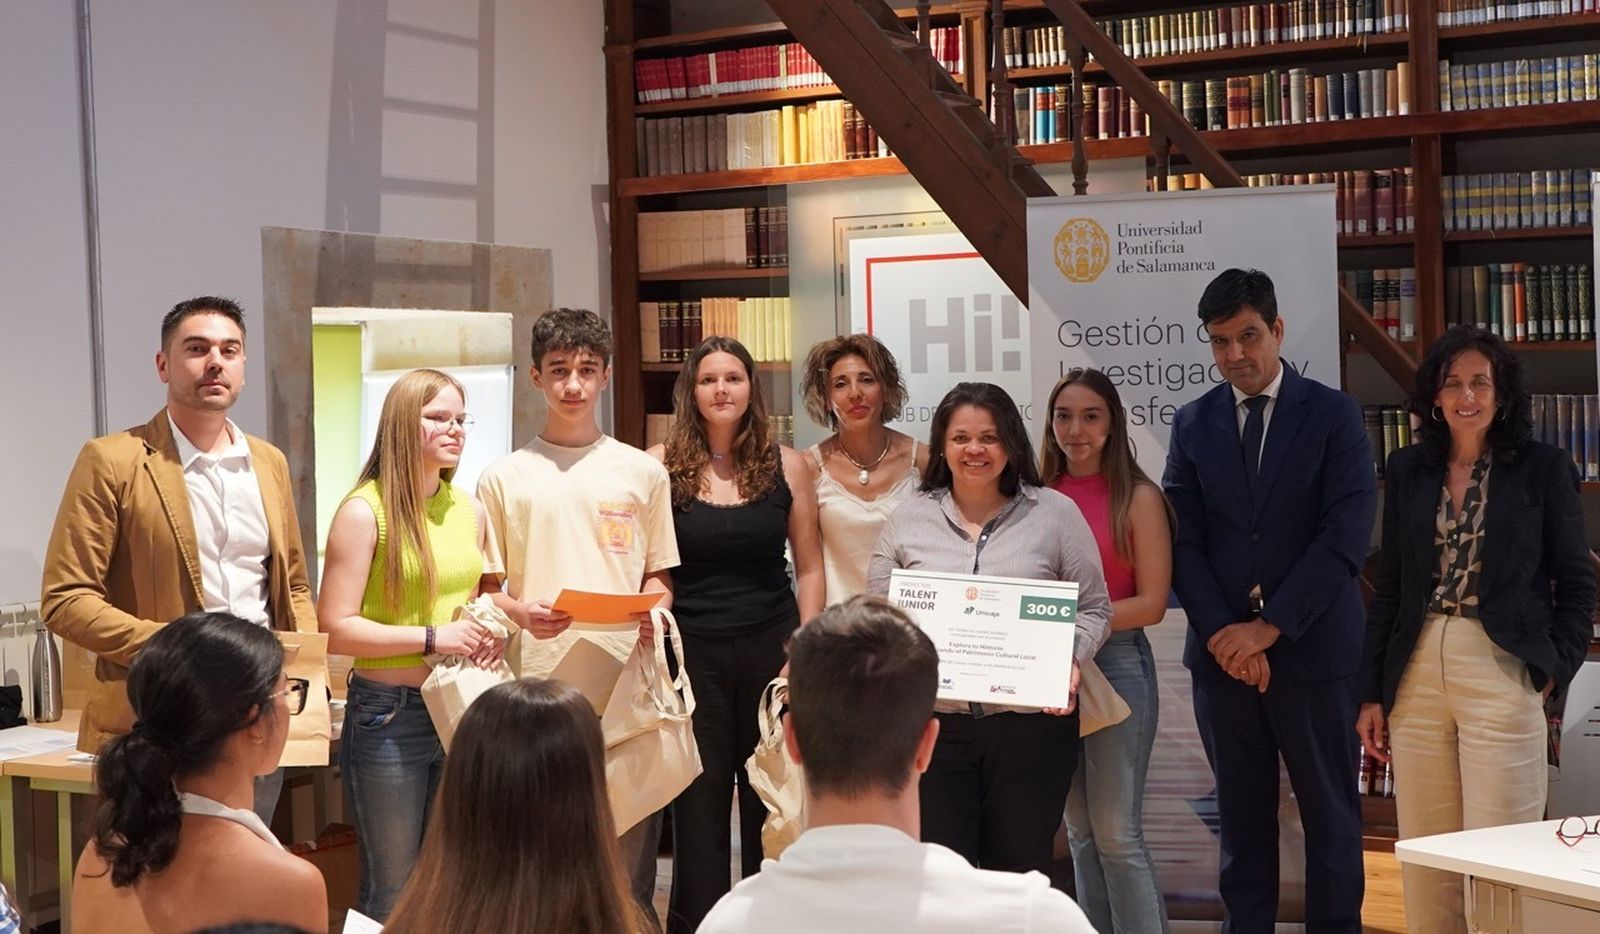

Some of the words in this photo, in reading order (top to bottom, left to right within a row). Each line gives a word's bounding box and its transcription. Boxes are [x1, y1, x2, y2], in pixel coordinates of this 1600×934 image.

[1117, 220, 1203, 238] Universidad
[1117, 240, 1186, 256] Pontificia
[1117, 260, 1134, 274] de
[1136, 259, 1215, 274] Salamanca
[908, 293, 1021, 374] Hi!
[1057, 316, 1185, 349] Gestión
[899, 588, 938, 600] TALENT
[897, 599, 935, 611] JUNIOR
[1026, 603, 1058, 616] 300
[1060, 605, 1071, 618] €
